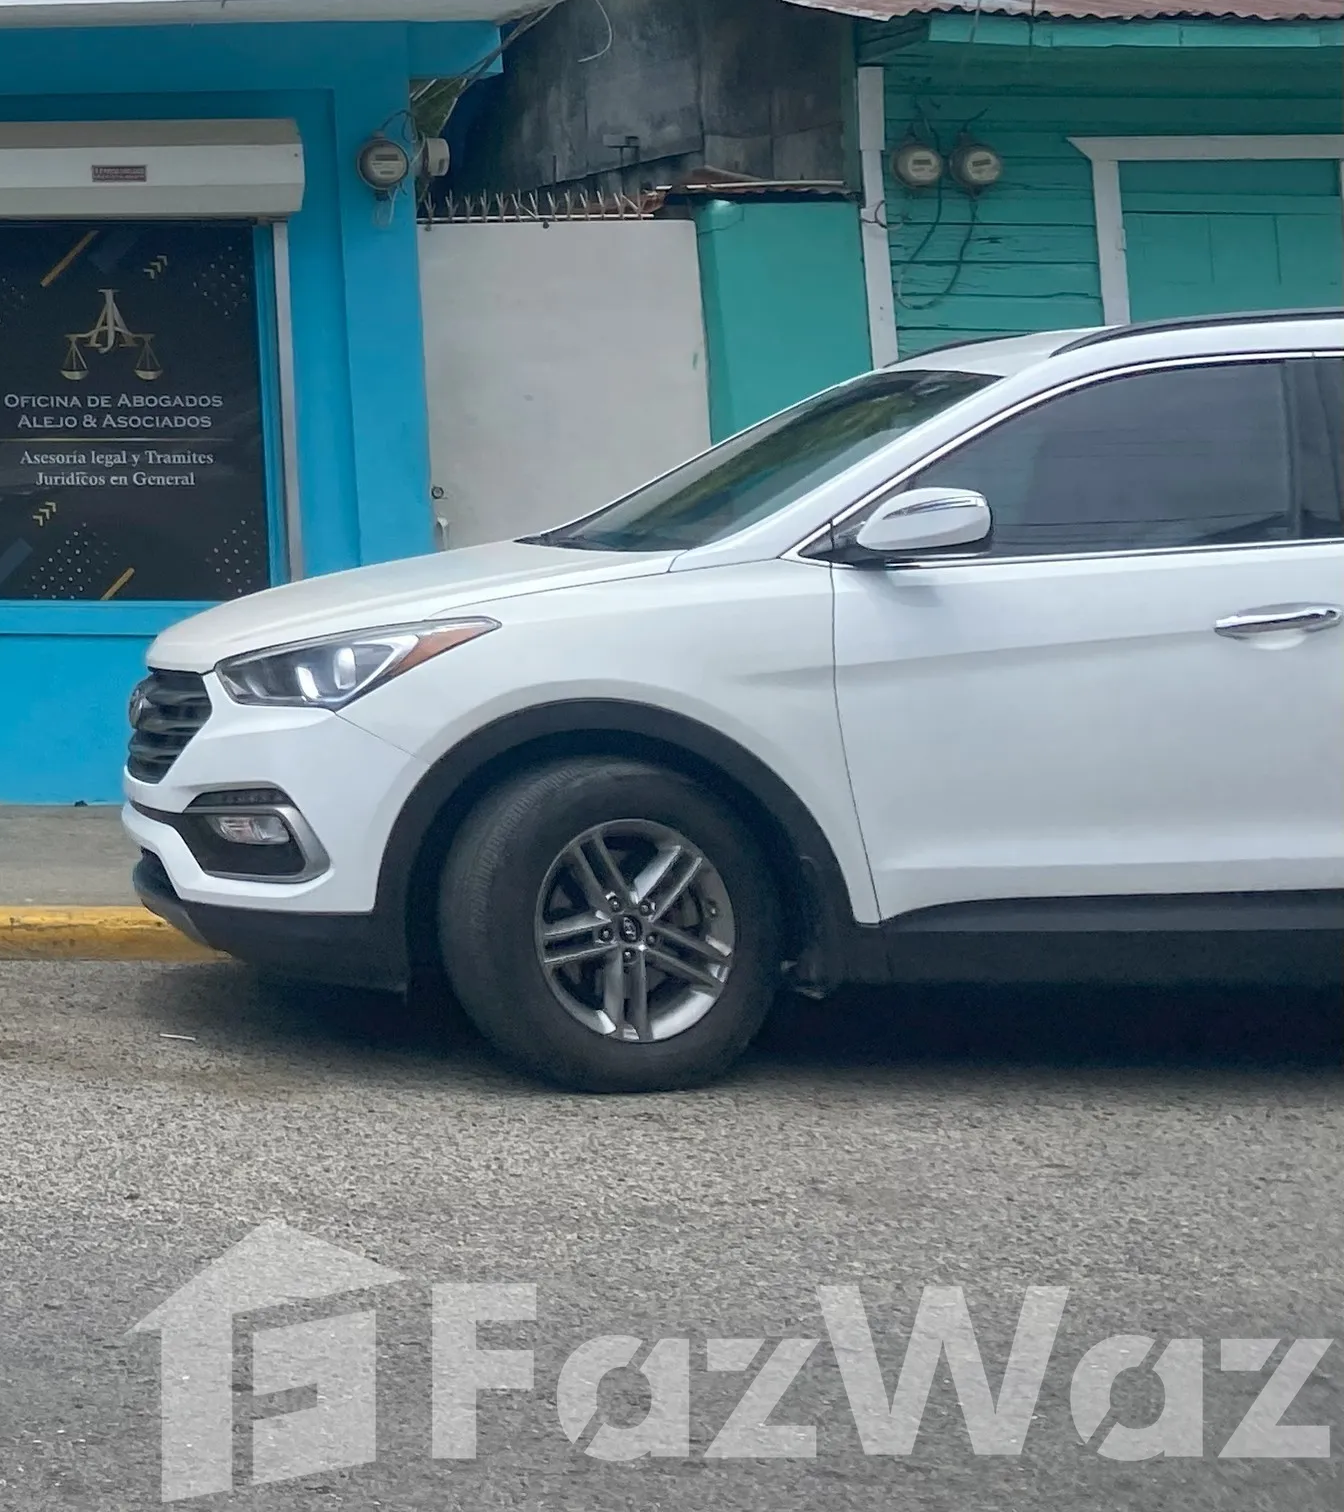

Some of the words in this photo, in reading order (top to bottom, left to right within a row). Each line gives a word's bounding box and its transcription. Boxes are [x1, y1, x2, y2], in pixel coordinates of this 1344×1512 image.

[4, 394, 81, 408] OFICINA
[87, 395, 111, 408] DE
[117, 394, 223, 408] ABOGADOS
[17, 414, 78, 429] ALEJO
[82, 414, 97, 428] &
[102, 414, 212, 428] ASOCIADOS
[91, 450, 126, 467] legal
[132, 454, 140, 467] y
[145, 450, 214, 465] Tramites
[110, 475, 128, 485] en
[132, 471, 196, 486] General
